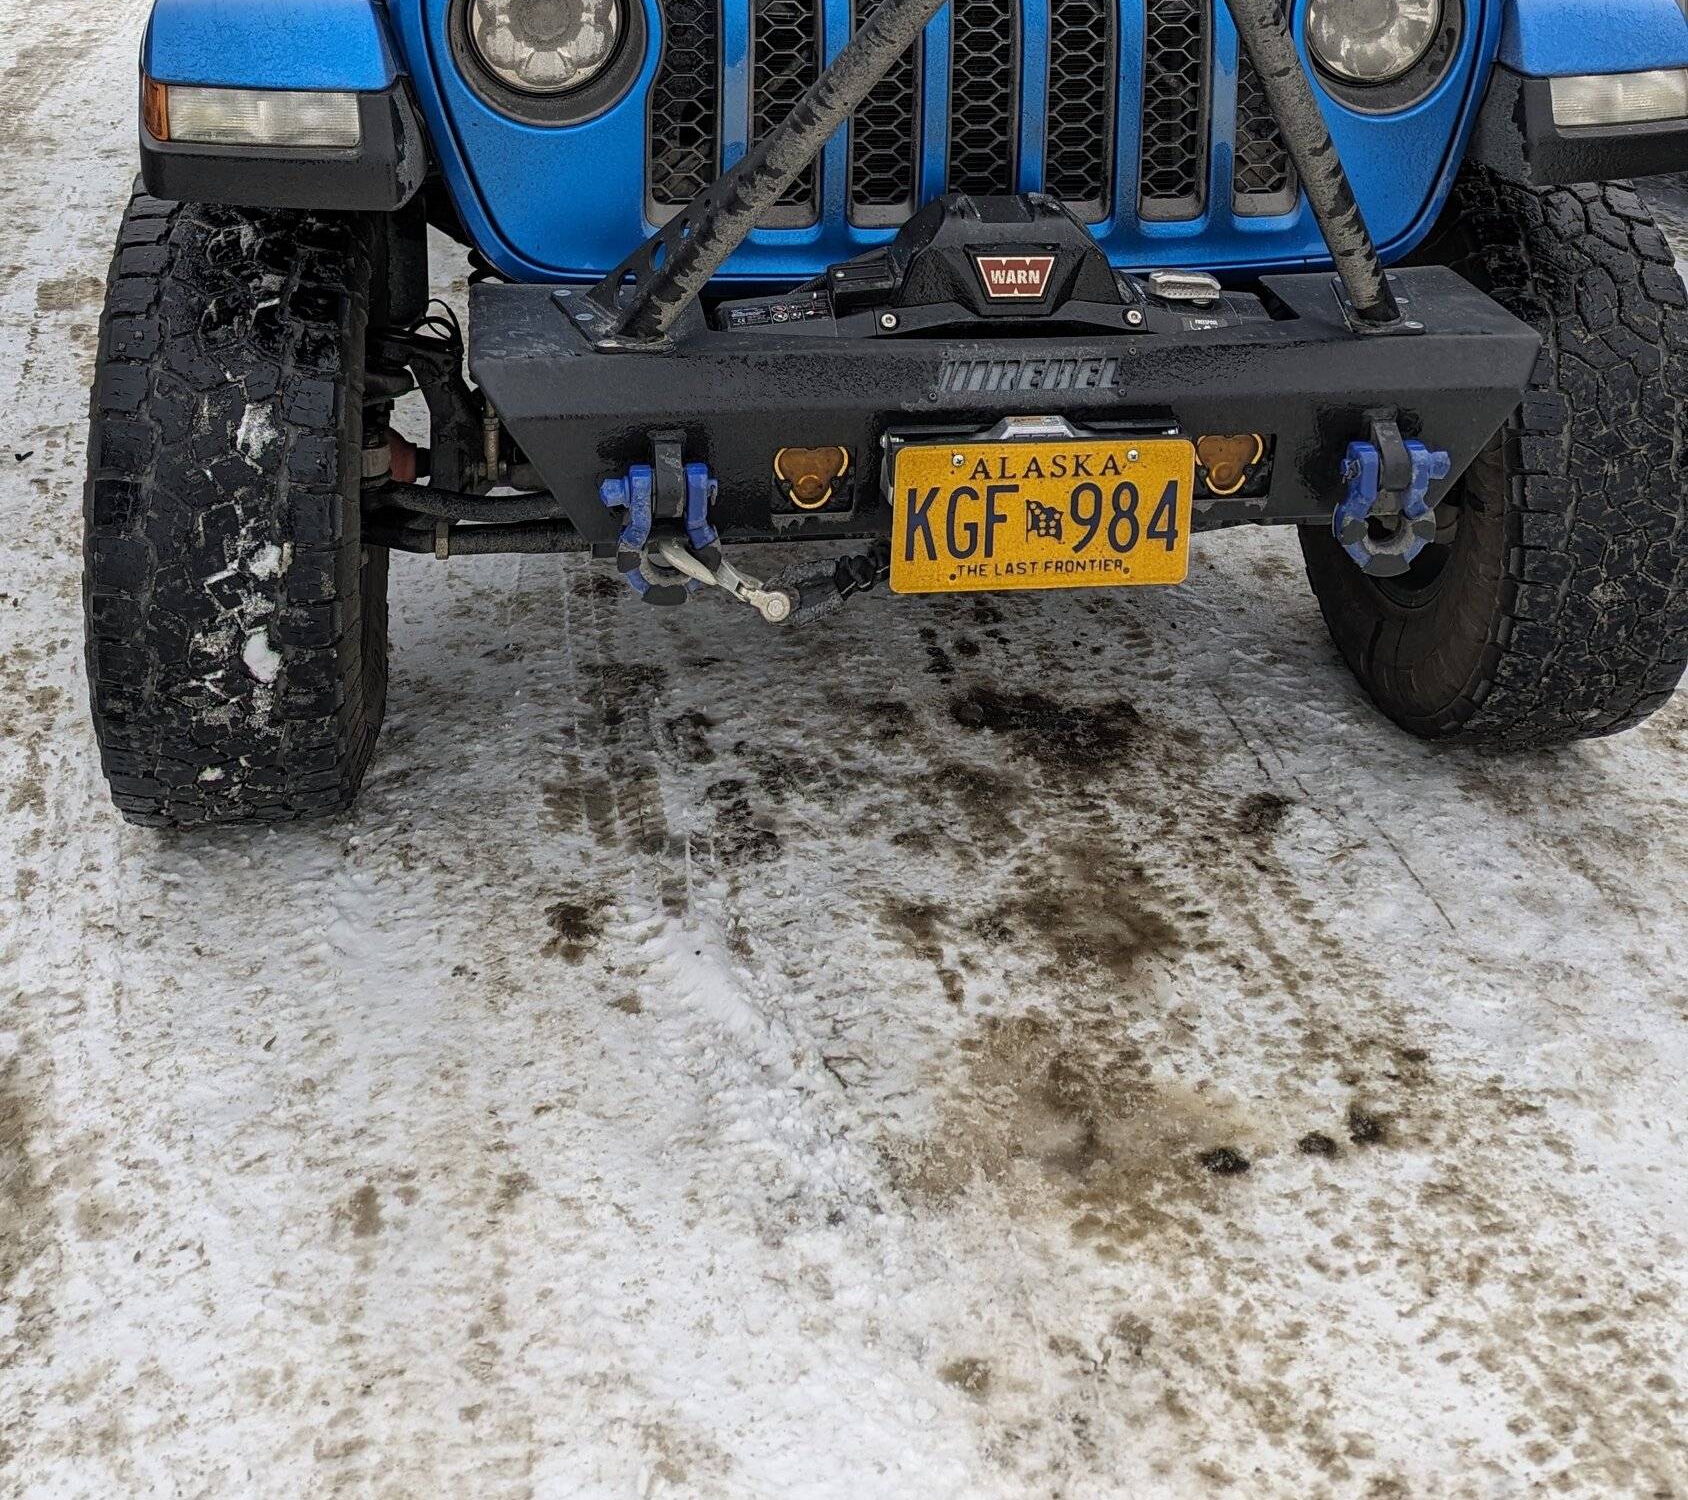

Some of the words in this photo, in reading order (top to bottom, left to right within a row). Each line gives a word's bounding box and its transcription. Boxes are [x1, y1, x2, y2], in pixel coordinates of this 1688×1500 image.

[990, 269, 1041, 285] WARN
[969, 454, 1122, 480] ALASKA
[904, 484, 1020, 562] KGF
[1070, 480, 1179, 554] 984
[956, 563, 988, 578] THE
[995, 561, 1038, 576] LAST
[1044, 558, 1123, 574] FRONTIER
